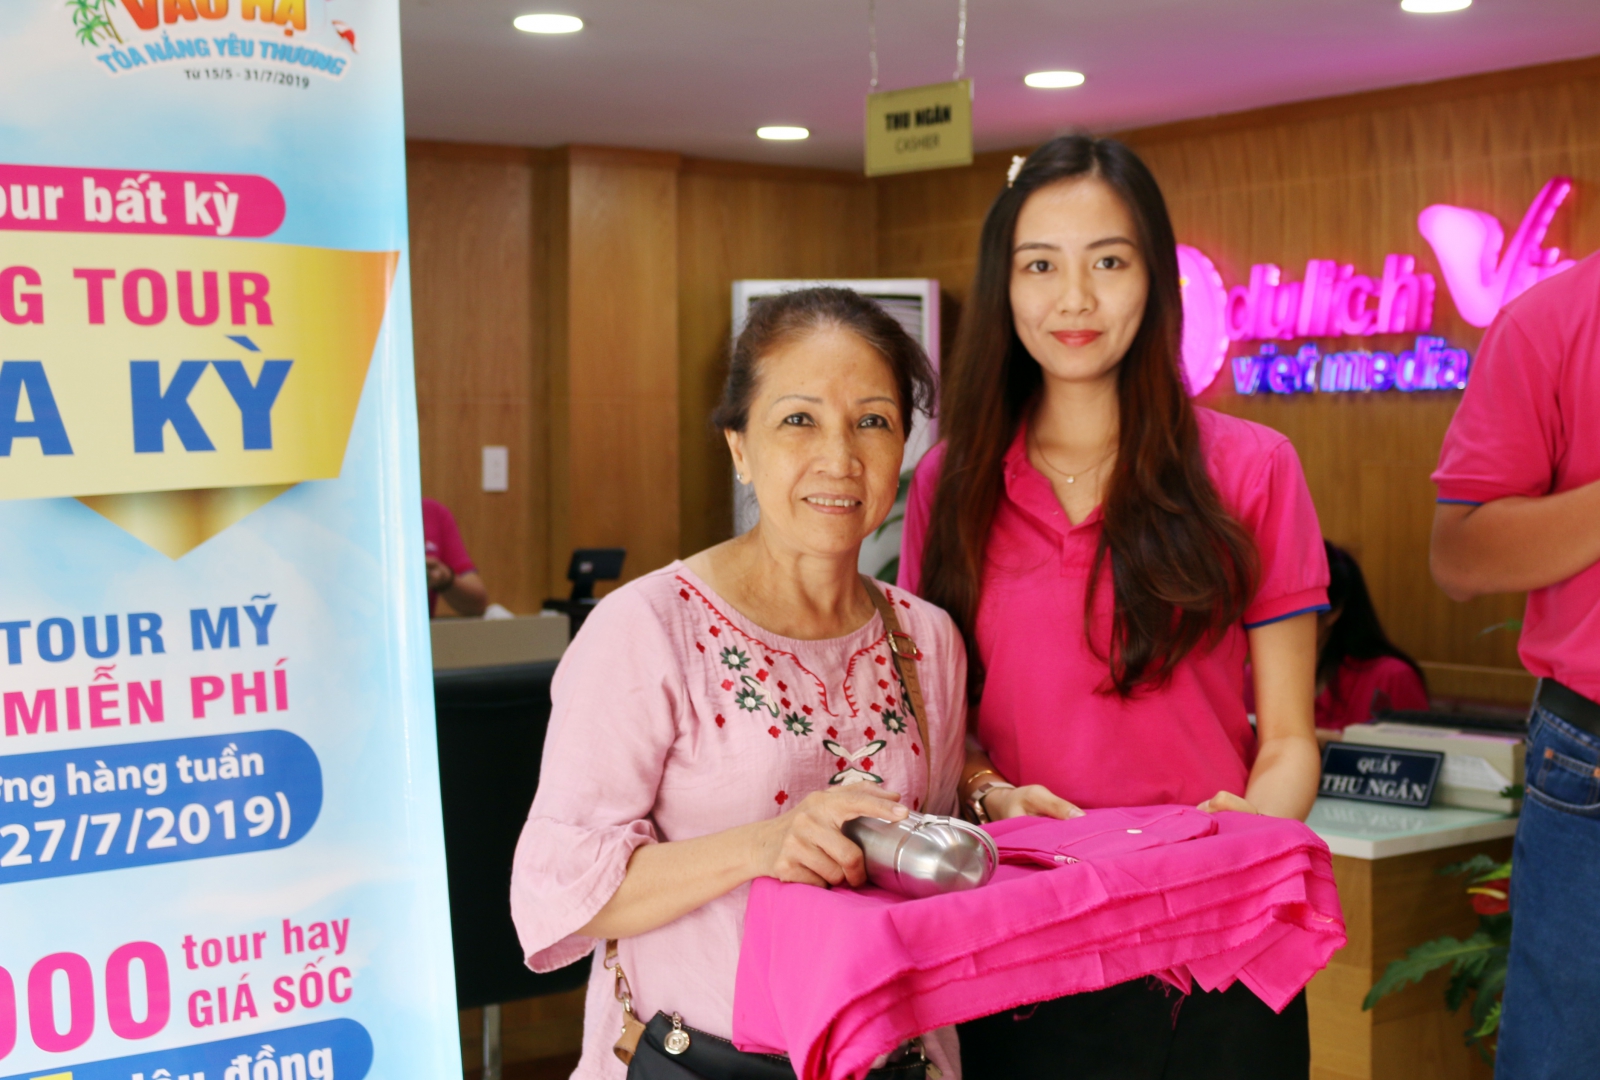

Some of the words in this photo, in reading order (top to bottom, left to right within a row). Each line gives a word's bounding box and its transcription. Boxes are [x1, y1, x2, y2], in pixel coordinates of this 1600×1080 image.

[204, 68, 233, 80] 15/5
[244, 68, 310, 89] 31/7/2019
[213, 33, 254, 57] YÊU
[259, 41, 347, 76] THƯƠNG
[82, 174, 167, 224] bất
[184, 180, 239, 236] kỳ
[73, 268, 274, 326] TOUR
[1320, 335, 1470, 392] media
[129, 335, 295, 453] KỲ
[0, 611, 166, 665] TOUR
[190, 593, 278, 651] MỸ
[3, 664, 165, 736] MIỄN
[190, 657, 289, 718] PHÍ
[66, 760, 167, 795] hàng
[177, 743, 264, 783] tuần
[1322, 774, 1363, 794] THU
[1365, 777, 1427, 800] NGÂN
[0, 791, 291, 867] 27/7/2019)
[182, 930, 267, 970] tour
[282, 918, 350, 955] hay
[187, 973, 259, 1028] GIÁ
[273, 956, 353, 1014] SỐC
